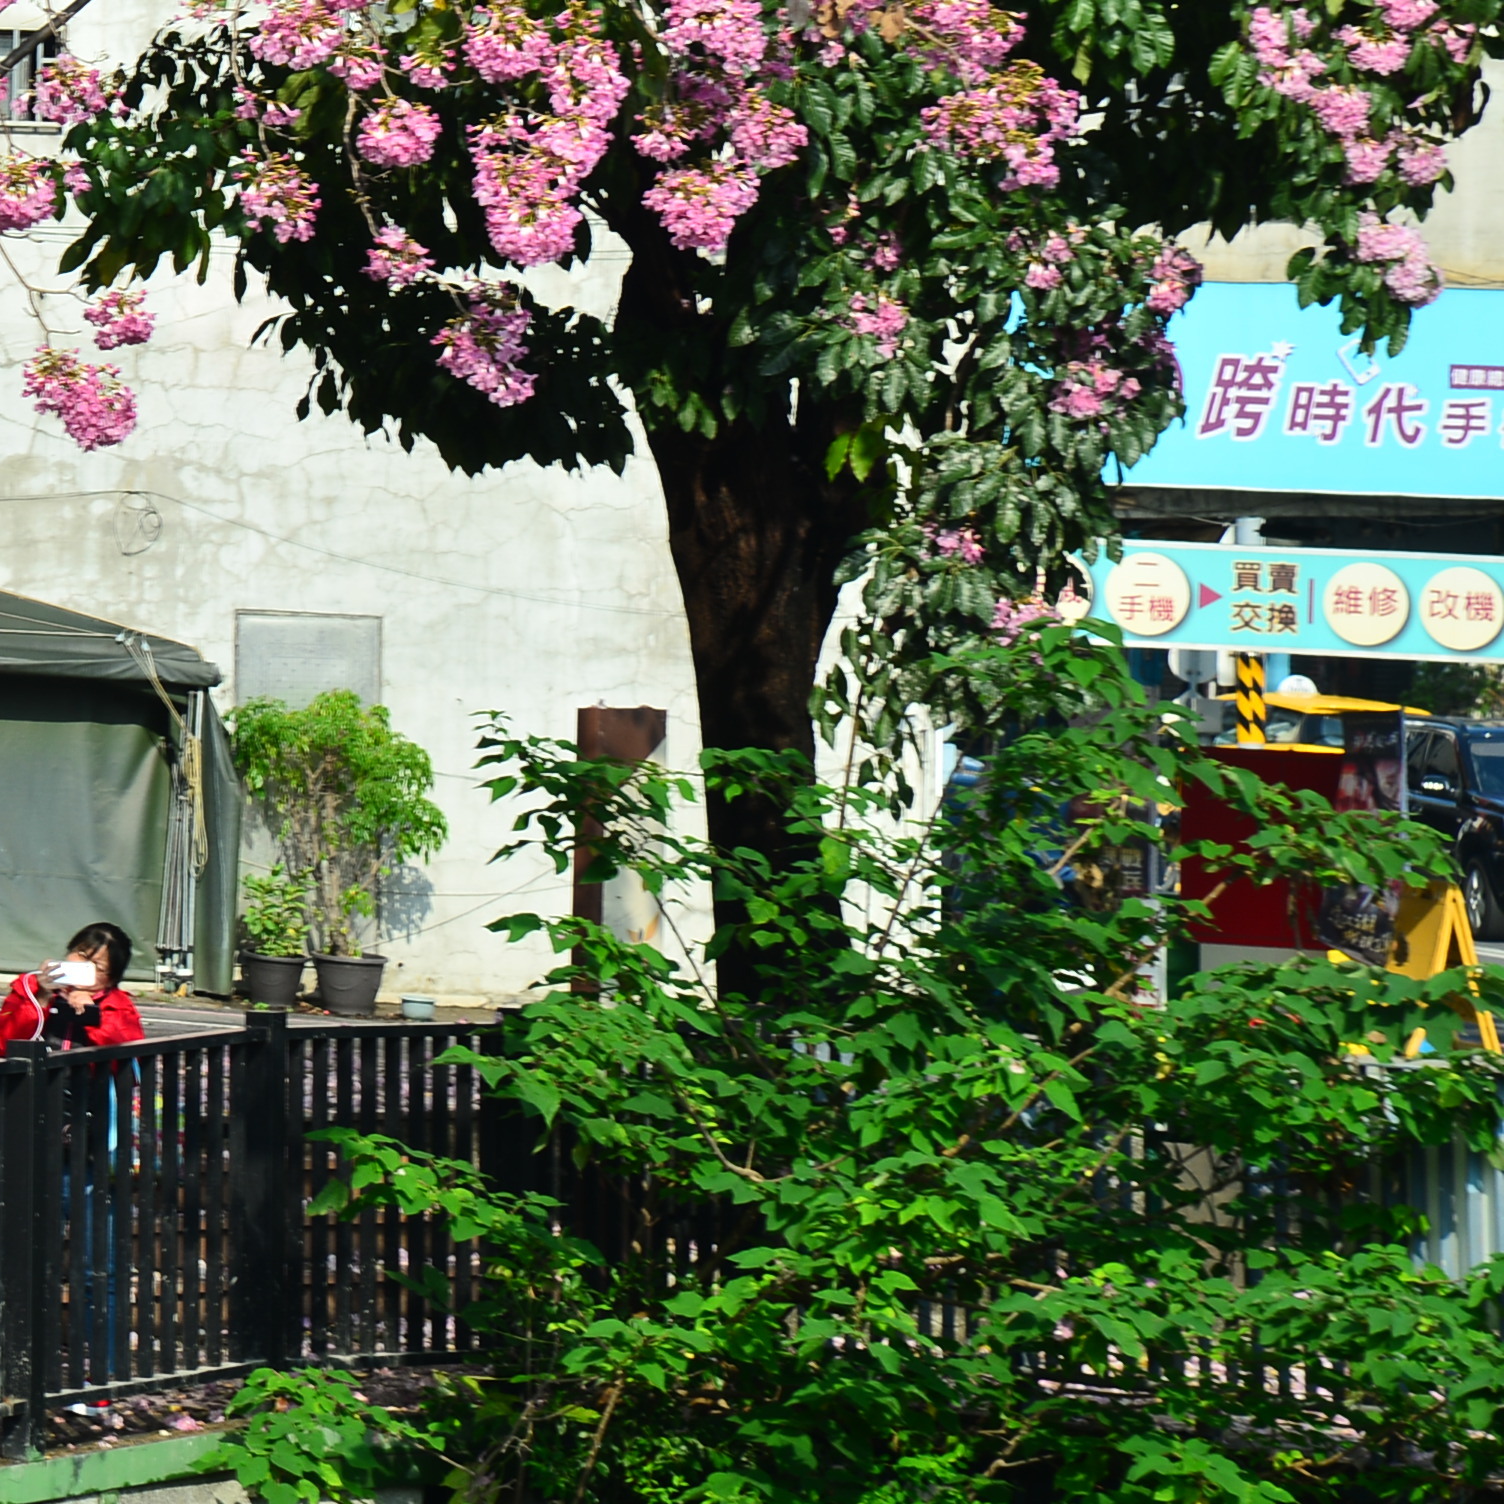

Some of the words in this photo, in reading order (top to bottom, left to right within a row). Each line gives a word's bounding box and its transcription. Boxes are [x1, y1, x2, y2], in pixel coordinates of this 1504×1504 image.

[1232, 562, 1298, 594] 買賣
[1118, 595, 1175, 622] 手機
[1333, 586, 1398, 616] 維修
[1429, 589, 1495, 621] 改機
[1231, 602, 1297, 633] 交換
